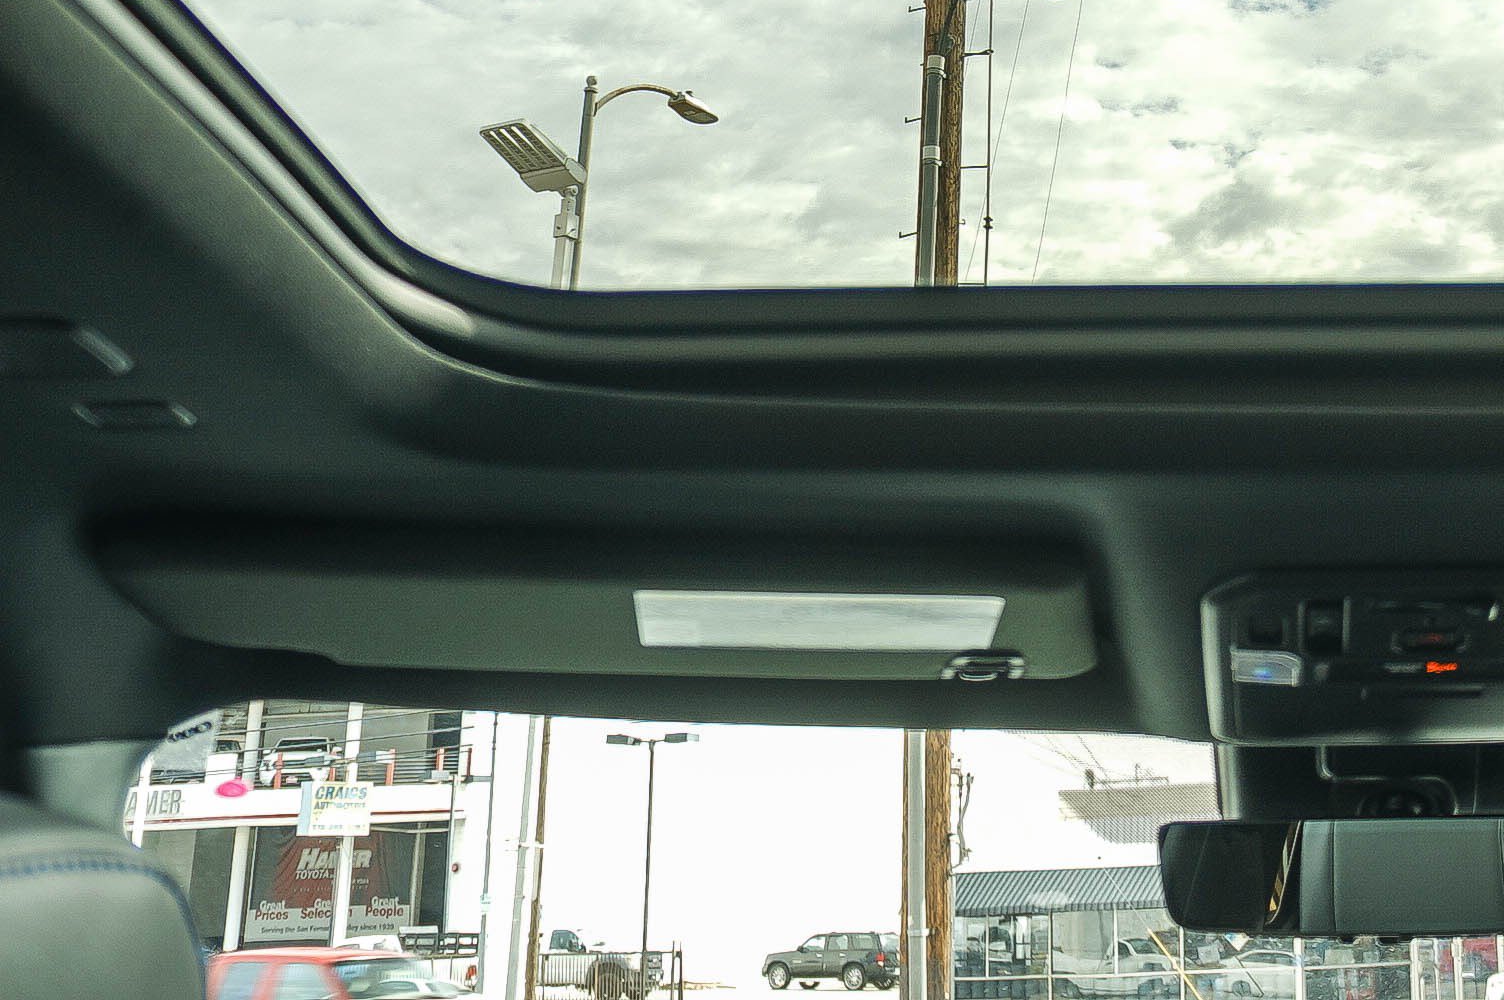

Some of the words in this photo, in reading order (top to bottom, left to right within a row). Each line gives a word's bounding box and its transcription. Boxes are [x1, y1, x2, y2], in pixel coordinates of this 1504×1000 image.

[260, 900, 285, 910] Great
[313, 898, 331, 909] Gre
[371, 896, 400, 907] Great
[255, 910, 289, 921] Prices
[300, 907, 353, 920] Selecn
[365, 906, 404, 919] People
[360, 922, 377, 931] since
